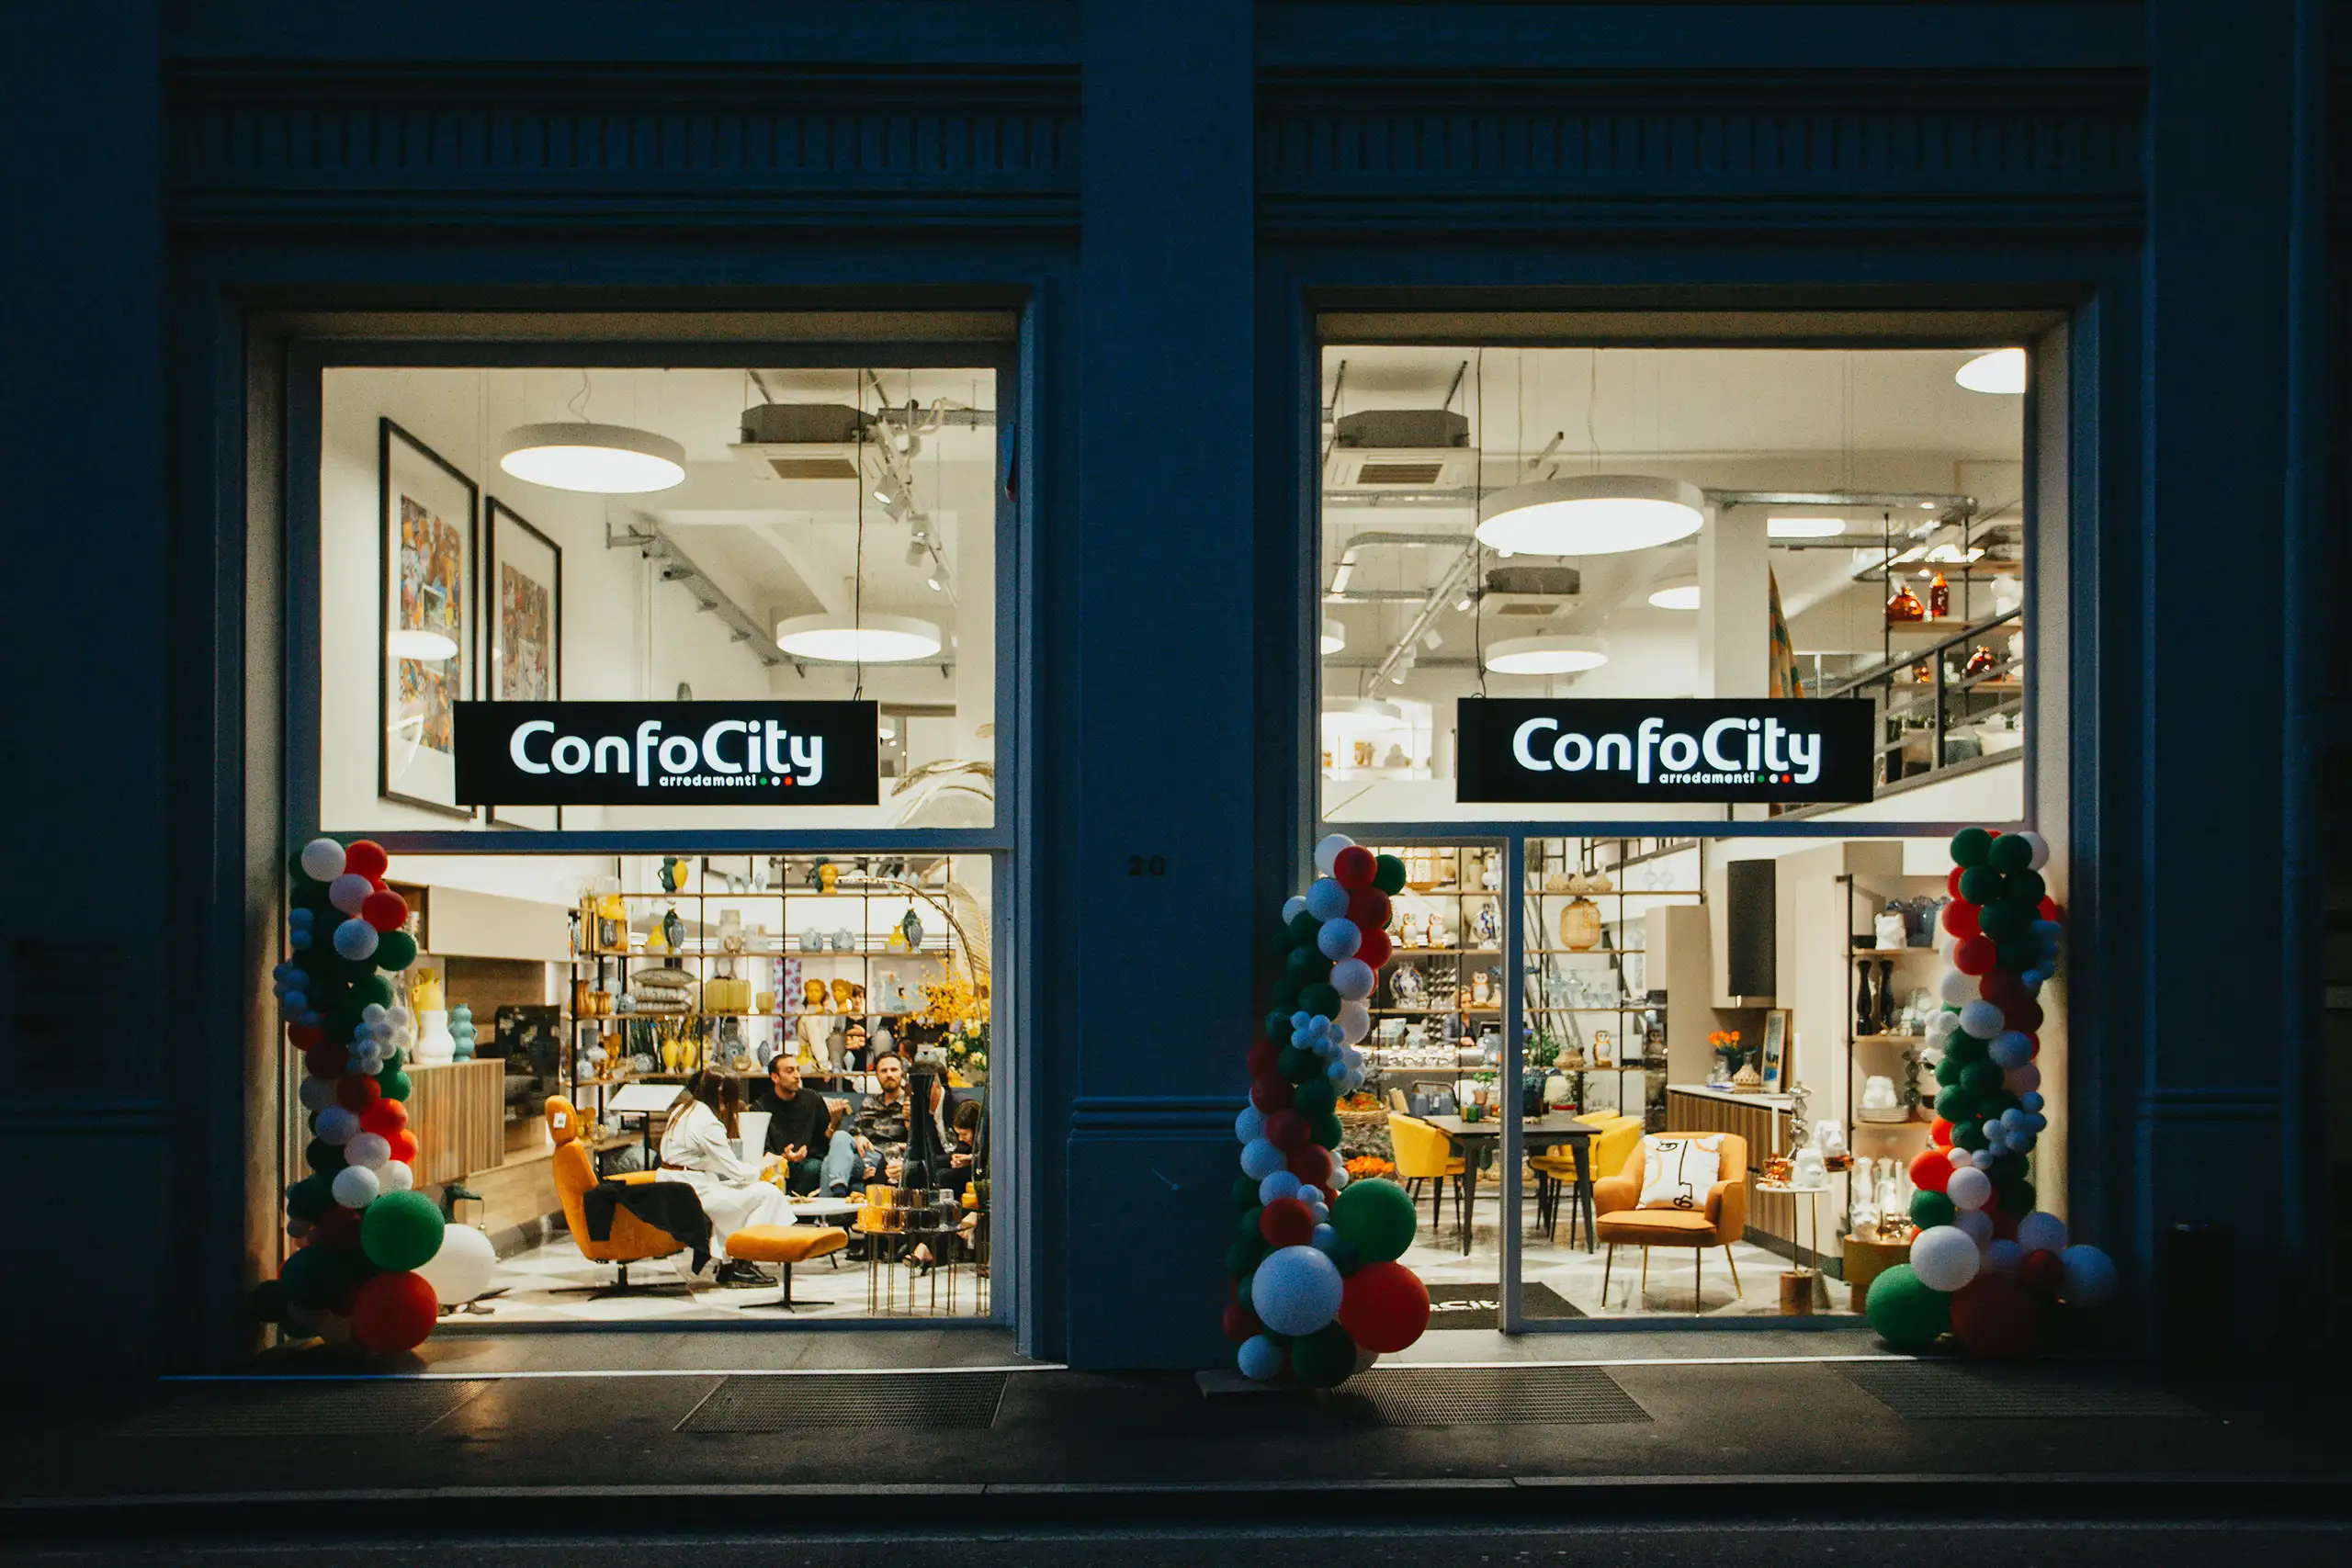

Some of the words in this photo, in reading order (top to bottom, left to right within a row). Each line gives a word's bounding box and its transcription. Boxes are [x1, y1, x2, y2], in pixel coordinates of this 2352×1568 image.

[510, 719, 823, 787] ConfoCity
[1512, 716, 1821, 784] ConfoCity
[659, 773, 757, 787] arredamenti
[1658, 771, 1756, 784] arredamenti
